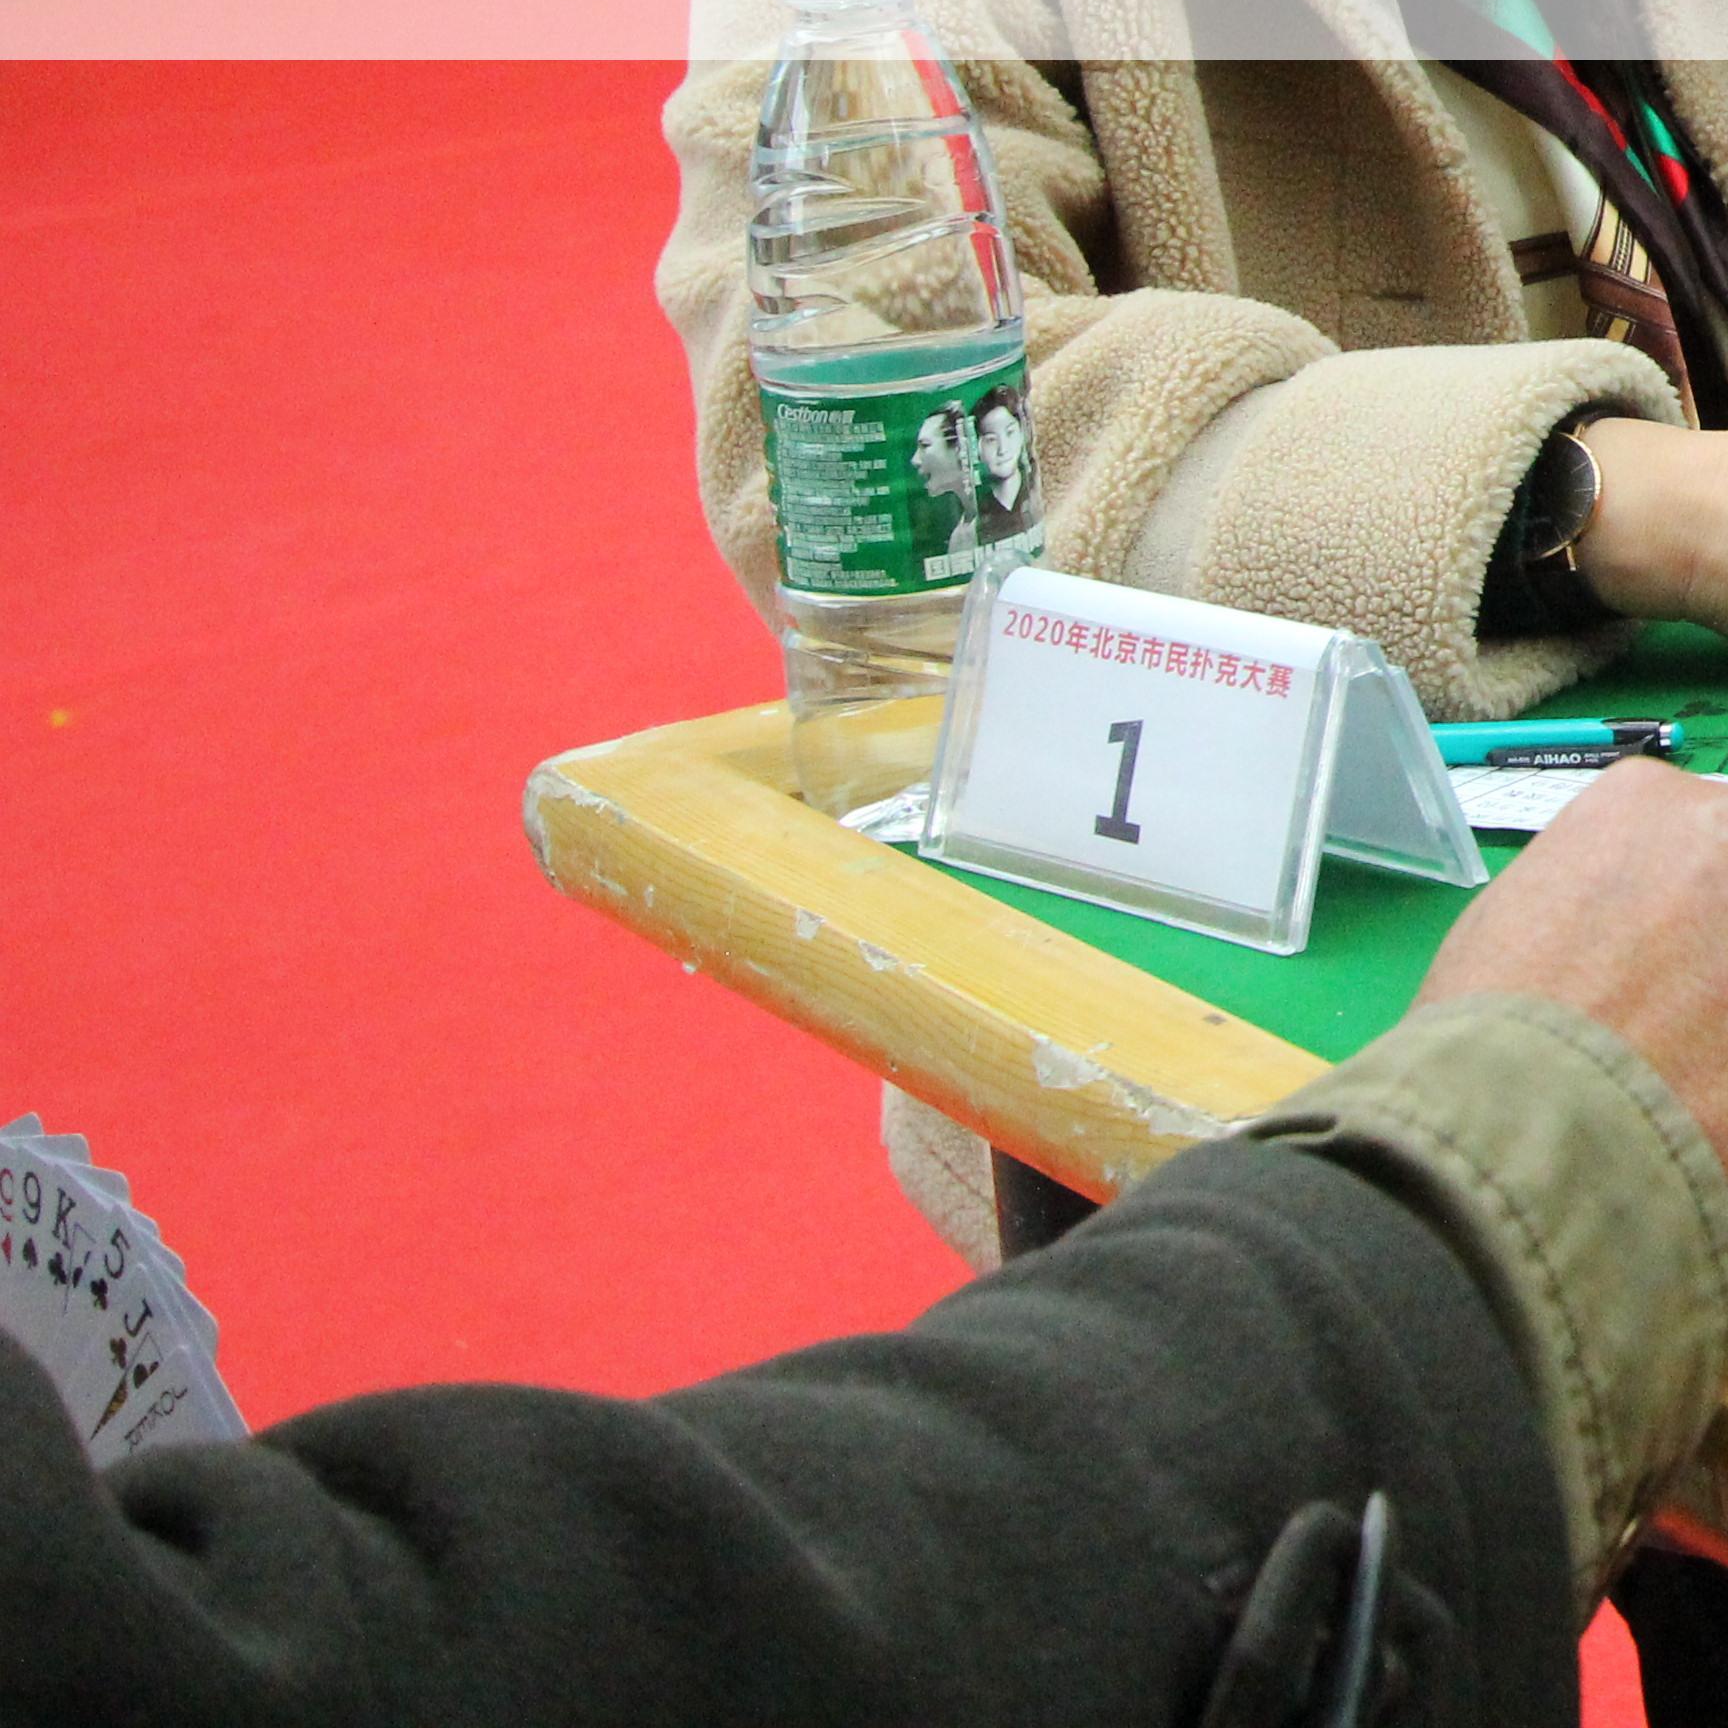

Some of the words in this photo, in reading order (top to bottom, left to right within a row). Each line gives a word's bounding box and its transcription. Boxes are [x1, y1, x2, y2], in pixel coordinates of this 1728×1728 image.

[1003, 609, 1295, 699] 2020年北京市民扑克大赛
[1094, 719, 1144, 845] 1
[23, 1171, 41, 1224] 9
[104, 1228, 131, 1280] 5
